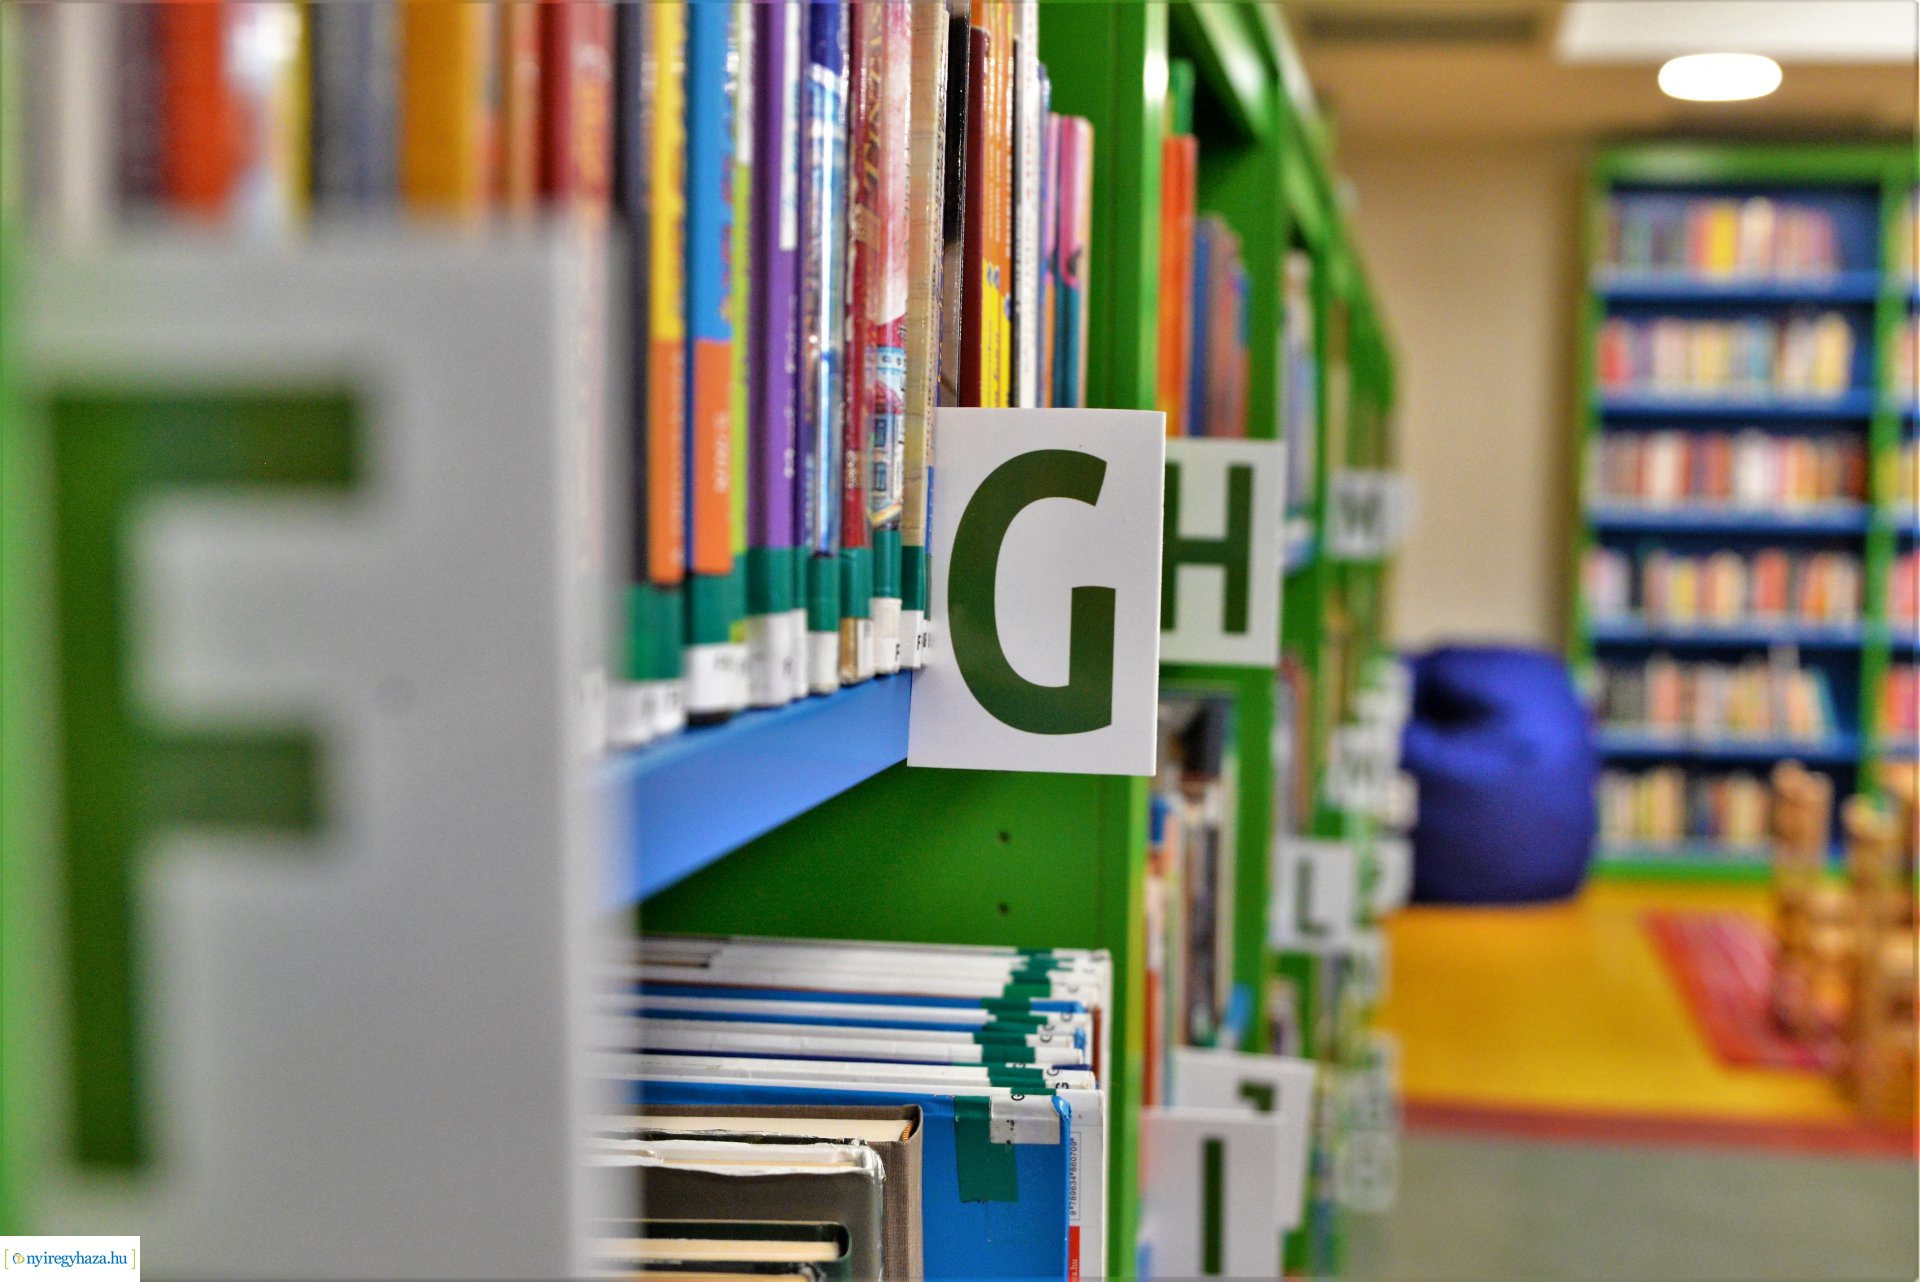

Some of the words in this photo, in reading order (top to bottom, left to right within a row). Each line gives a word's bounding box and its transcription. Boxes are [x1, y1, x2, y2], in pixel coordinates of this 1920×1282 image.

[947, 449, 1116, 735] G
[1161, 461, 1254, 635] H
[48, 382, 366, 1170] F
[1295, 856, 1329, 938] L
[1202, 1135, 1225, 1276] I
